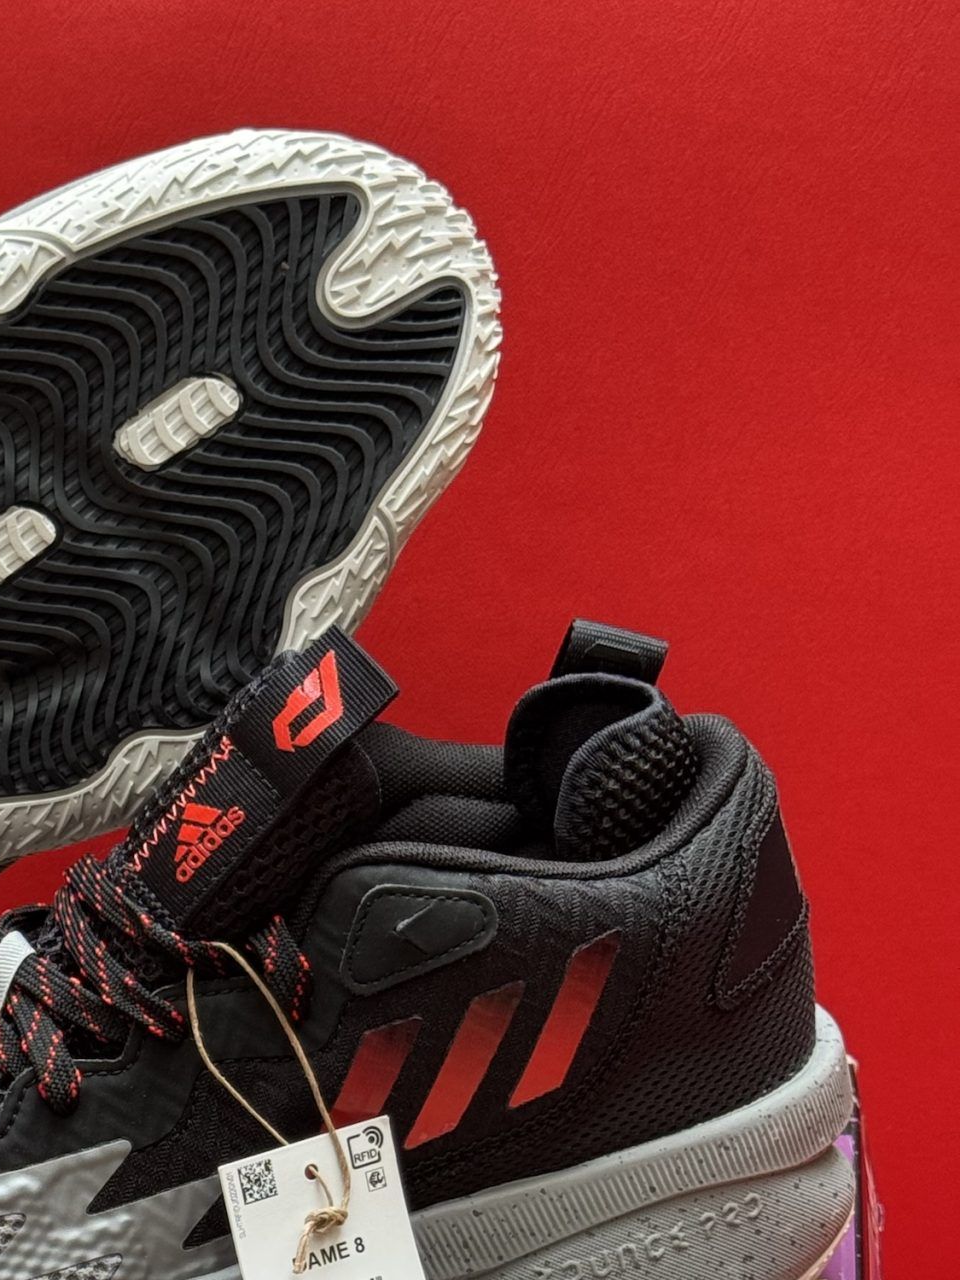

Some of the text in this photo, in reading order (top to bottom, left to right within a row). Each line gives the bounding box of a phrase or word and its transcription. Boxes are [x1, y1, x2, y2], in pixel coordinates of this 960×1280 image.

[175, 806, 246, 883] adidas
[353, 1148, 378, 1164] RFID
[353, 1236, 366, 1254] 8
